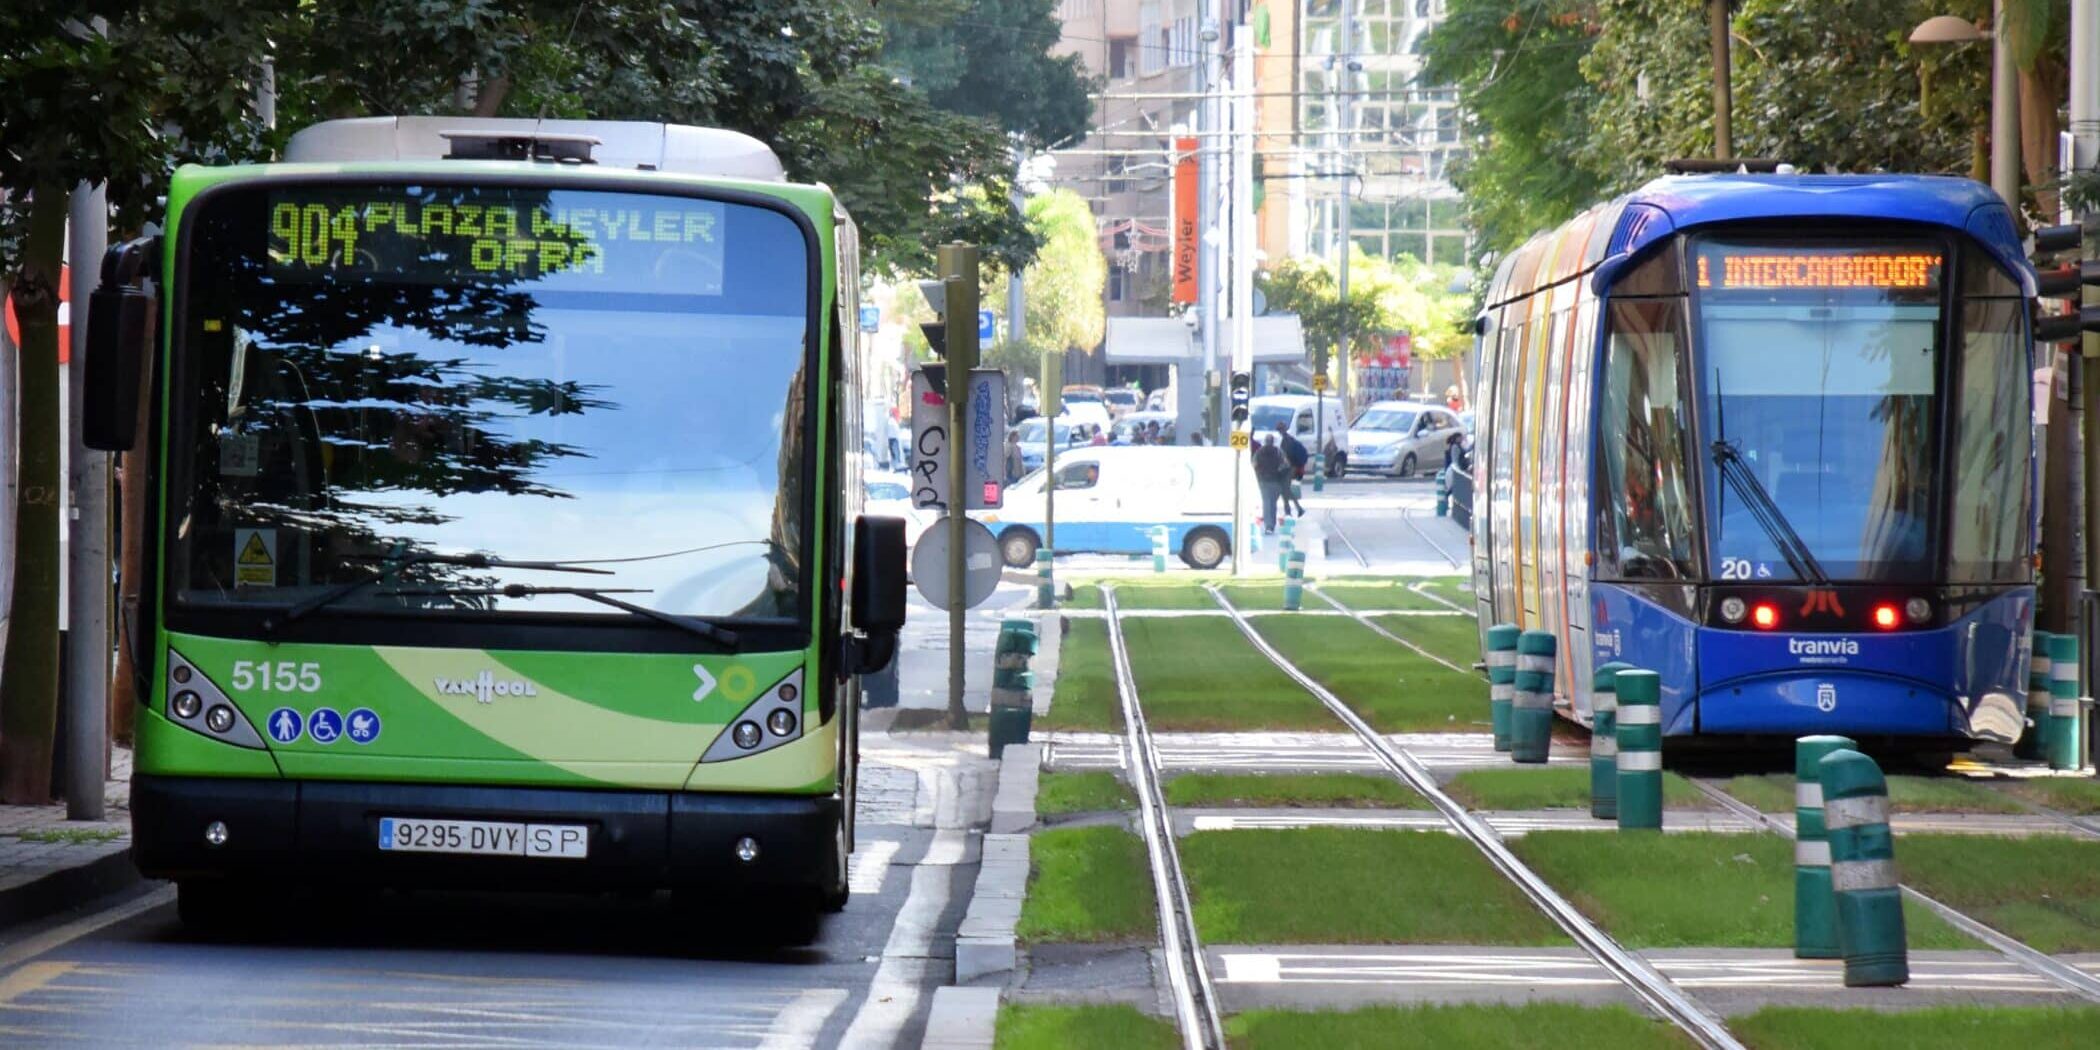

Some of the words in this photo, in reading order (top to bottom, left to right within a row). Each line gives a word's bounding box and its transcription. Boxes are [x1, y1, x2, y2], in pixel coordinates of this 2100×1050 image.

[272, 203, 358, 265] 904
[366, 202, 517, 237] PLAZA
[532, 207, 716, 242] WEYLER
[470, 239, 604, 274] OFRA
[1178, 219, 1196, 283] Weyler
[1697, 255, 1710, 288] 1
[1231, 435, 1249, 446] 20
[1721, 559, 1752, 580] 20
[232, 660, 321, 692] 5155
[398, 823, 462, 849] 9295
[471, 827, 518, 850] DVY
